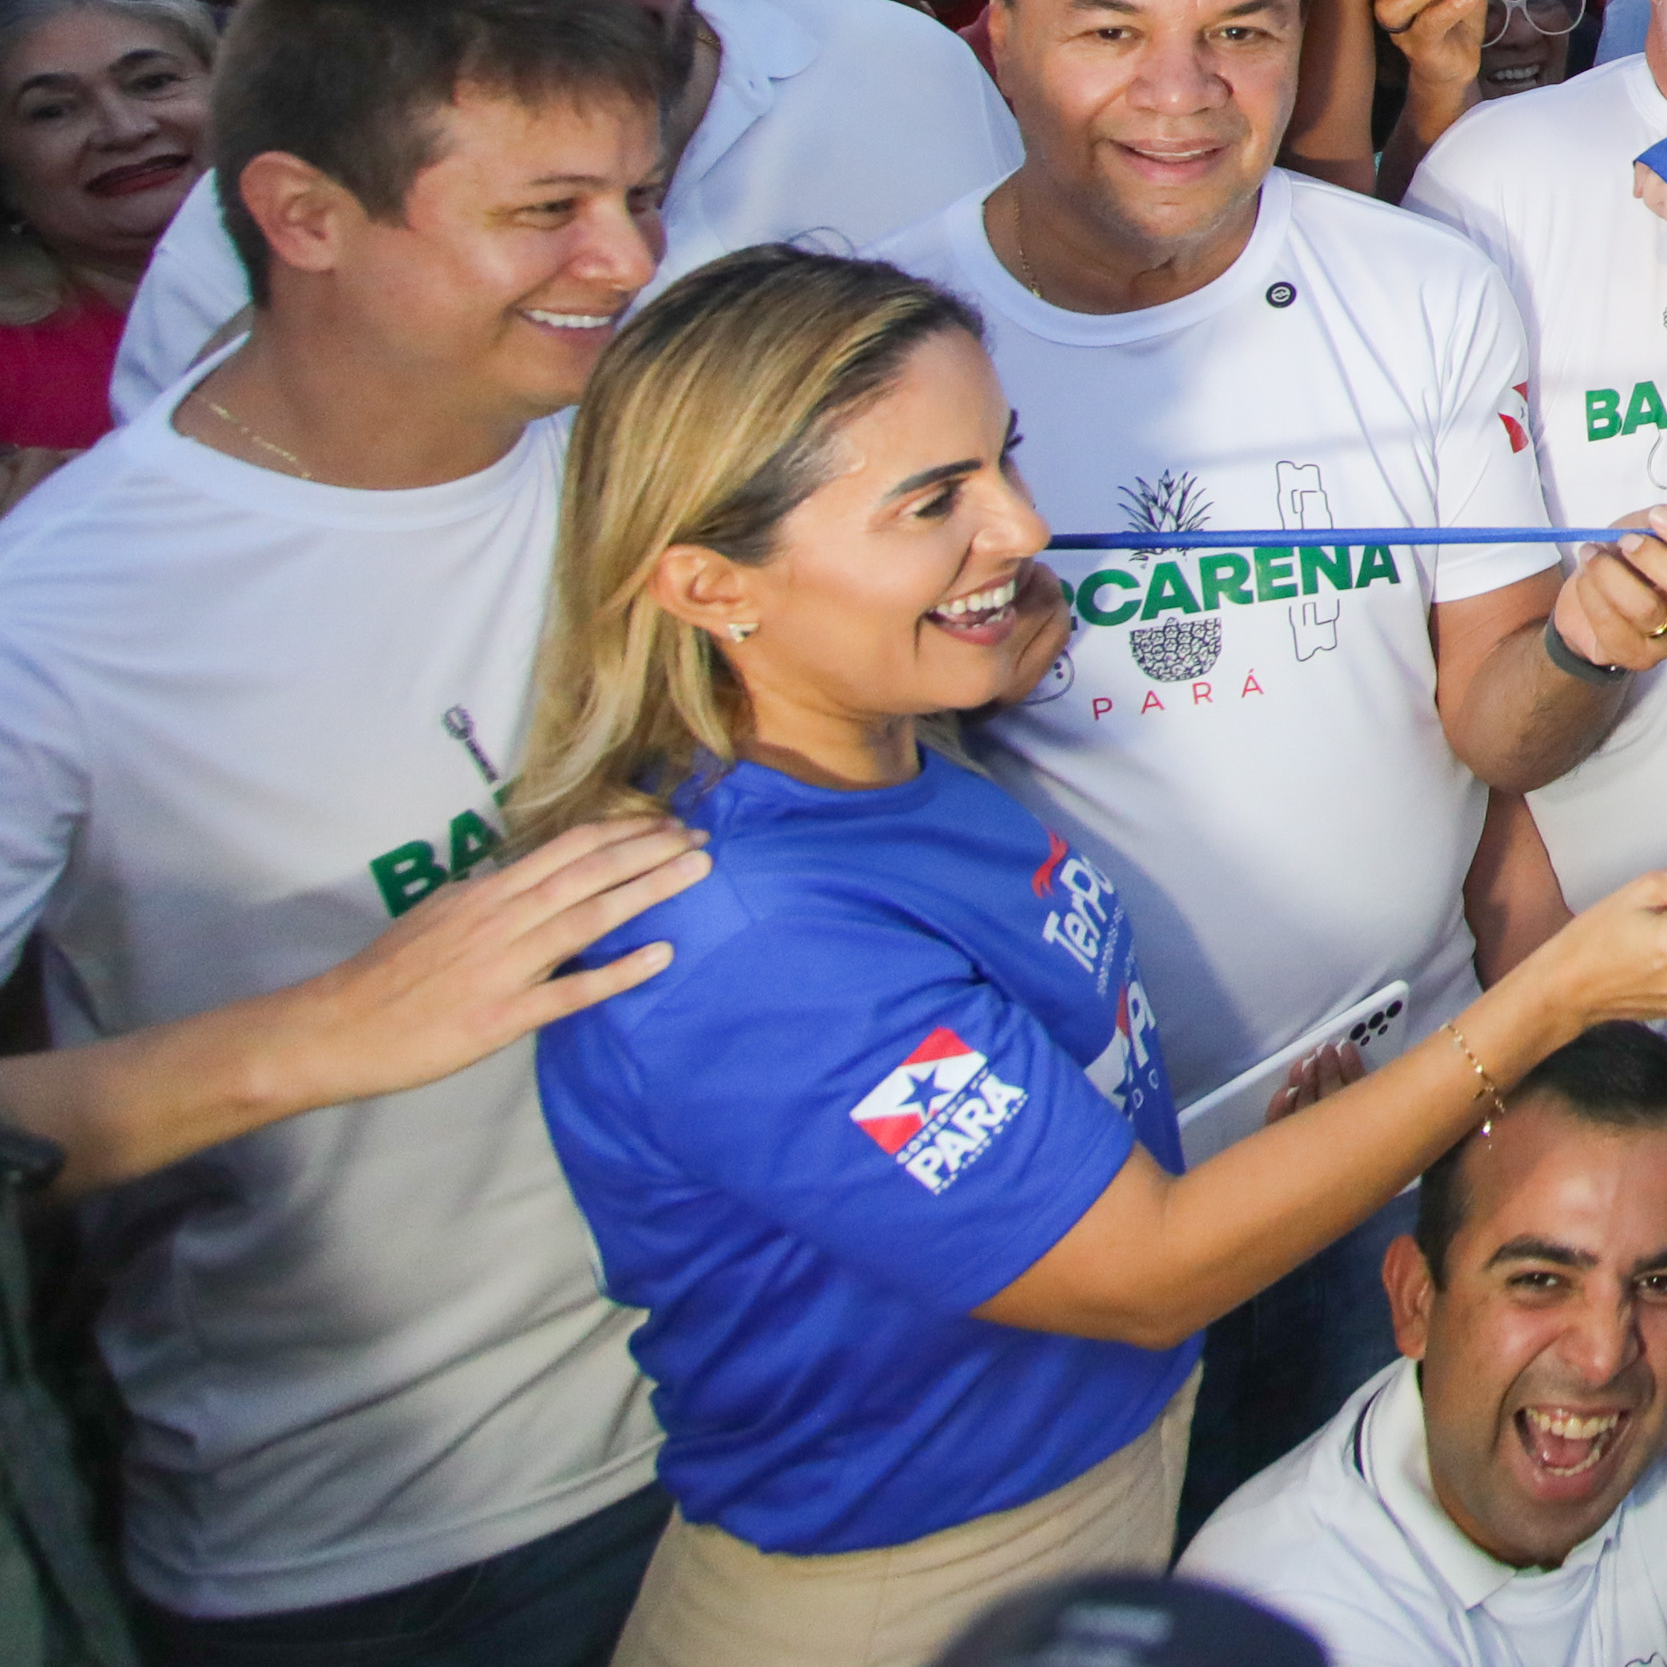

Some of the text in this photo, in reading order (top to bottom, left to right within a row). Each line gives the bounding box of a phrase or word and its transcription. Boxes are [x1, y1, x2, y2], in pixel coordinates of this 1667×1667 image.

[1059, 544, 1400, 632] CARENA
[1092, 669, 1264, 721] PARÁ
[369, 784, 512, 919] BA
